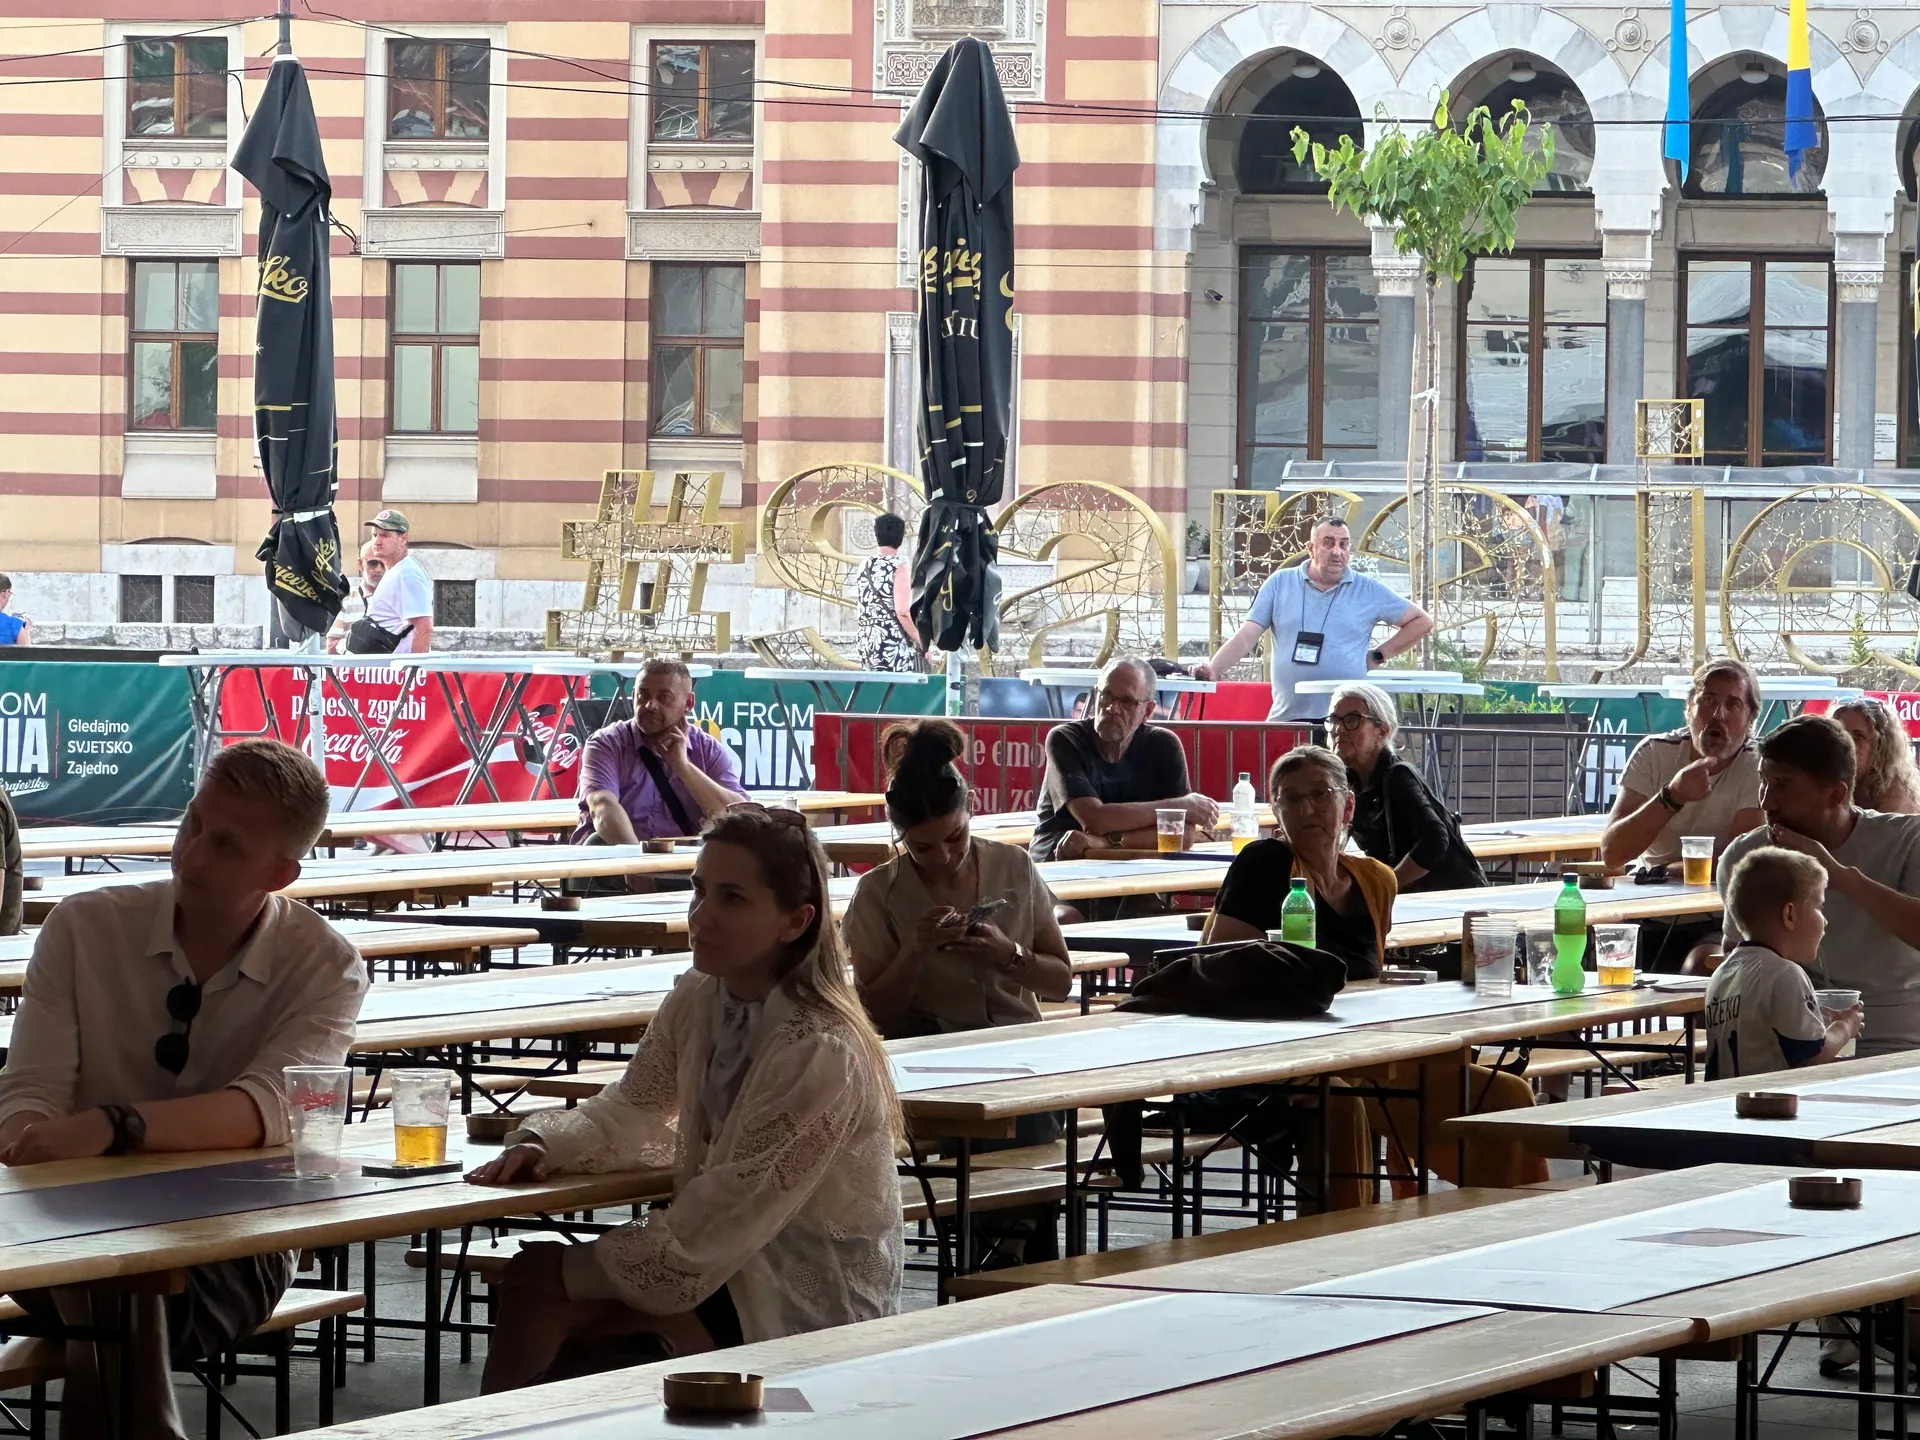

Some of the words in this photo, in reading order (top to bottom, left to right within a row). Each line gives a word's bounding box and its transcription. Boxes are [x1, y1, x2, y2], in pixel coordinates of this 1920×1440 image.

[0, 691, 47, 716] OM
[733, 702, 814, 728] FROM
[68, 718, 130, 735] Gledajmo
[0, 717, 49, 774] IA
[67, 740, 133, 754] SVJETSKO
[66, 760, 119, 778] Zajedno
